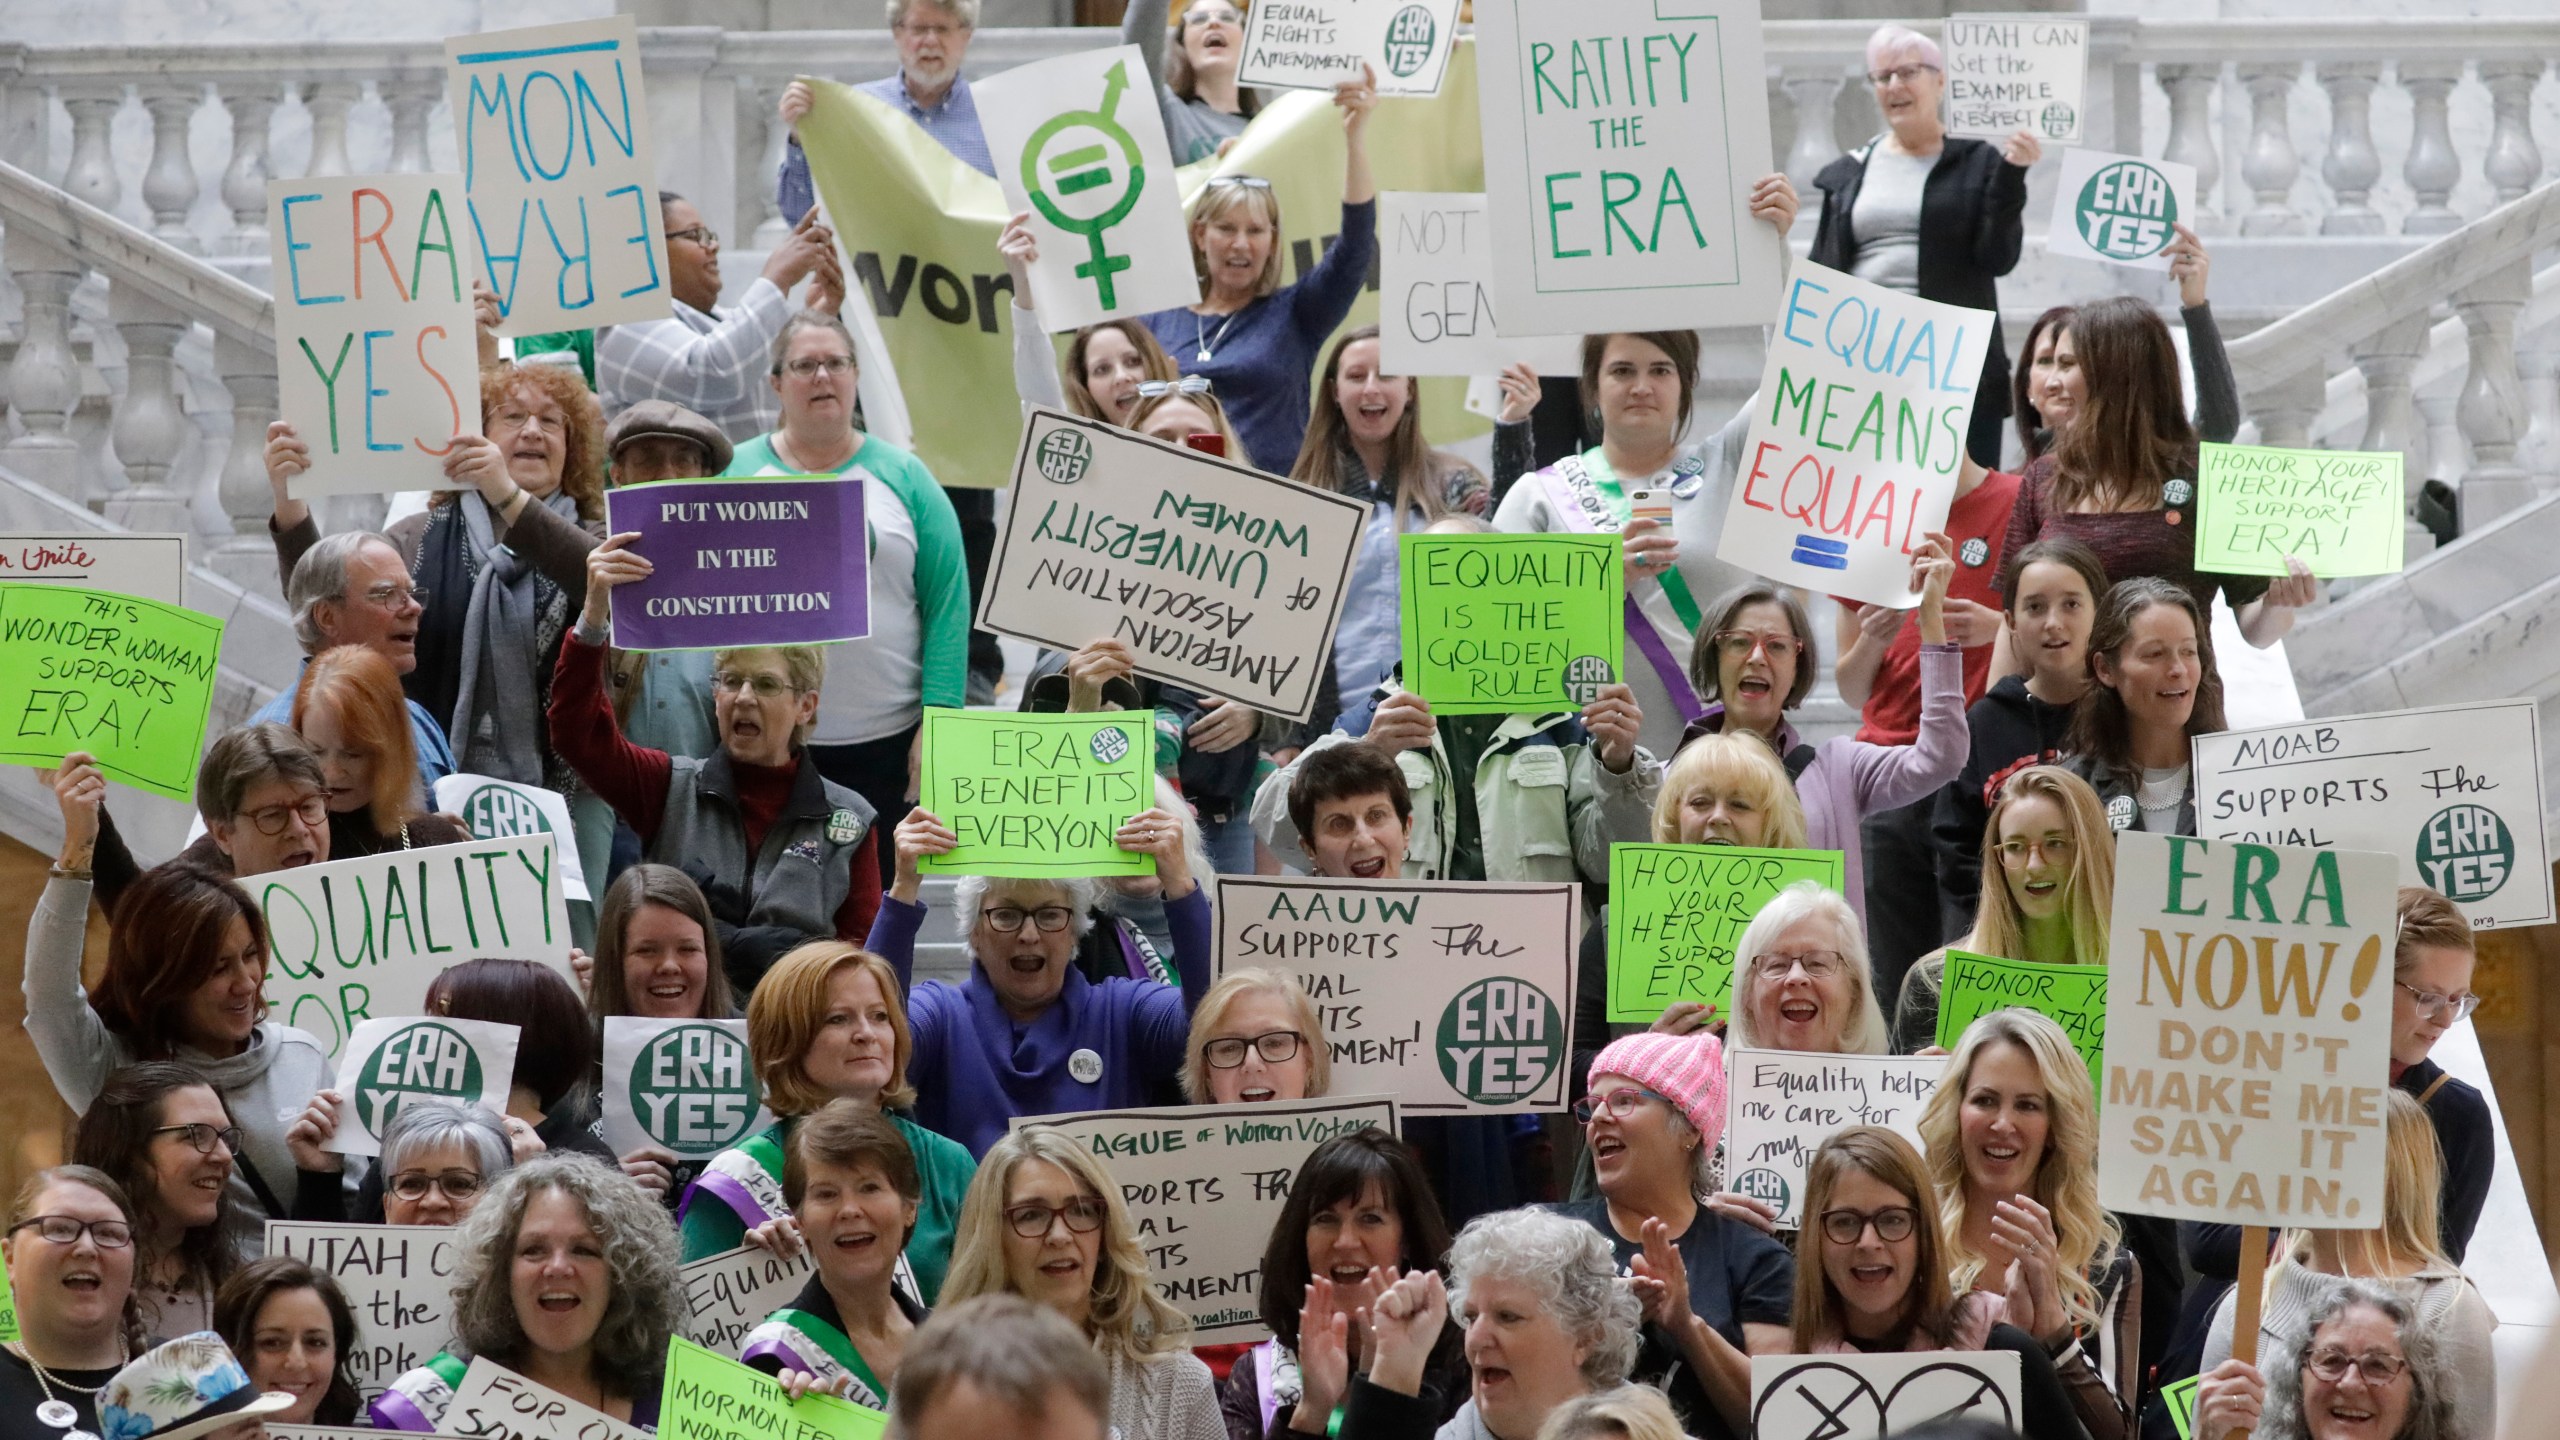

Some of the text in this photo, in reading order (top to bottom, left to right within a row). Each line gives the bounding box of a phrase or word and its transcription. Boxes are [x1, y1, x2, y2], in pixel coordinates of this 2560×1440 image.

[1264, 4, 1335, 24] EQUAL
[1393, 5, 1431, 42] ERA
[1261, 24, 1337, 44] RIGHTS
[1951, 24, 2079, 48] UTAH CAN
[1250, 48, 1361, 71] AMENDMENT
[1388, 43, 1427, 73] YES
[1531, 32, 1697, 114] RATIFY
[1951, 53, 2033, 74] Set the
[1952, 80, 2052, 102] EXAMPLE
[1589, 115, 1646, 149] THE
[1953, 109, 2034, 128] RESPECT
[2093, 164, 2166, 217] ERA
[1545, 166, 1708, 258] ERA
[282, 188, 461, 306] ERA
[1397, 210, 1480, 254] NOT
[2083, 209, 2166, 256] YES
[1784, 277, 1970, 393] EQUAL
[298, 325, 460, 457] YES
[1772, 366, 1963, 475] MEANS
[2166, 479, 2189, 495] ERA
[2211, 451, 2383, 484] HONOR YOUR
[661, 500, 810, 522] PUT WOMEN
[1743, 440, 1923, 556] EQUAL
[2164, 491, 2187, 504] YES
[2235, 499, 2363, 524] SUPPORT
[1153, 490, 1308, 557] WOMEN
[22, 542, 96, 570] Unite
[697, 548, 776, 569] IN THE
[1030, 500, 1269, 599] UNIVERSITY
[1961, 551, 1986, 566] YES
[1965, 538, 1987, 555] ERA
[1428, 548, 1612, 590] EQUALITY
[85, 596, 138, 623] THIS
[646, 591, 831, 617] CONSTITUTION
[1026, 558, 1253, 639] ASSOCIATION
[1445, 601, 1564, 631] IS THE
[5, 618, 216, 682] WONDER WOMAN
[1428, 638, 1569, 671] GOLDEN
[1570, 656, 1608, 682] ERA
[39, 657, 176, 704] SUPPORTS
[1468, 668, 1554, 698] RULE
[993, 730, 1081, 769] ERA
[1091, 727, 1120, 751] ERA
[1096, 738, 1128, 763] YES
[2232, 727, 2340, 767] MOAB
[951, 771, 1136, 805] BENEFITS
[2107, 798, 2132, 816] ERA
[2213, 765, 2499, 819] SUPPORTS The
[473, 788, 540, 838] ERA
[832, 812, 857, 829] ERA
[2107, 815, 2132, 830] YES
[2428, 806, 2499, 856] ERA
[828, 826, 857, 841] YES
[1632, 852, 1784, 895] HONOR
[2161, 835, 2352, 928] ERA
[2422, 853, 2505, 899] YES
[1268, 891, 1420, 926] AAUW
[1238, 923, 1525, 959] SUPPORTS The
[1955, 963, 2054, 1002] HONOR
[2136, 927, 2382, 1022] NOW!
[267, 983, 371, 1059] OR
[1457, 981, 1545, 1041] ERA
[376, 1027, 468, 1091] ERA
[652, 1029, 742, 1088] ERA
[1444, 1046, 1548, 1095] YES
[1753, 1064, 1868, 1111] Equality
[2109, 1065, 2381, 1128] MAKE ME
[639, 1093, 747, 1141] YES
[1742, 1101, 1900, 1126] me care for
[1075, 1129, 1186, 1159] AGUE
[1225, 1119, 1292, 1146] Women
[1747, 1134, 1807, 1168] my
[2130, 1115, 2357, 1171] SAY IT
[1741, 1170, 1781, 1197] ERA
[2138, 1163, 2361, 1219] AGAIN.
[367, 1289, 440, 1329] the
[481, 1375, 567, 1432] FOR
[676, 1380, 788, 1440] MORMON
